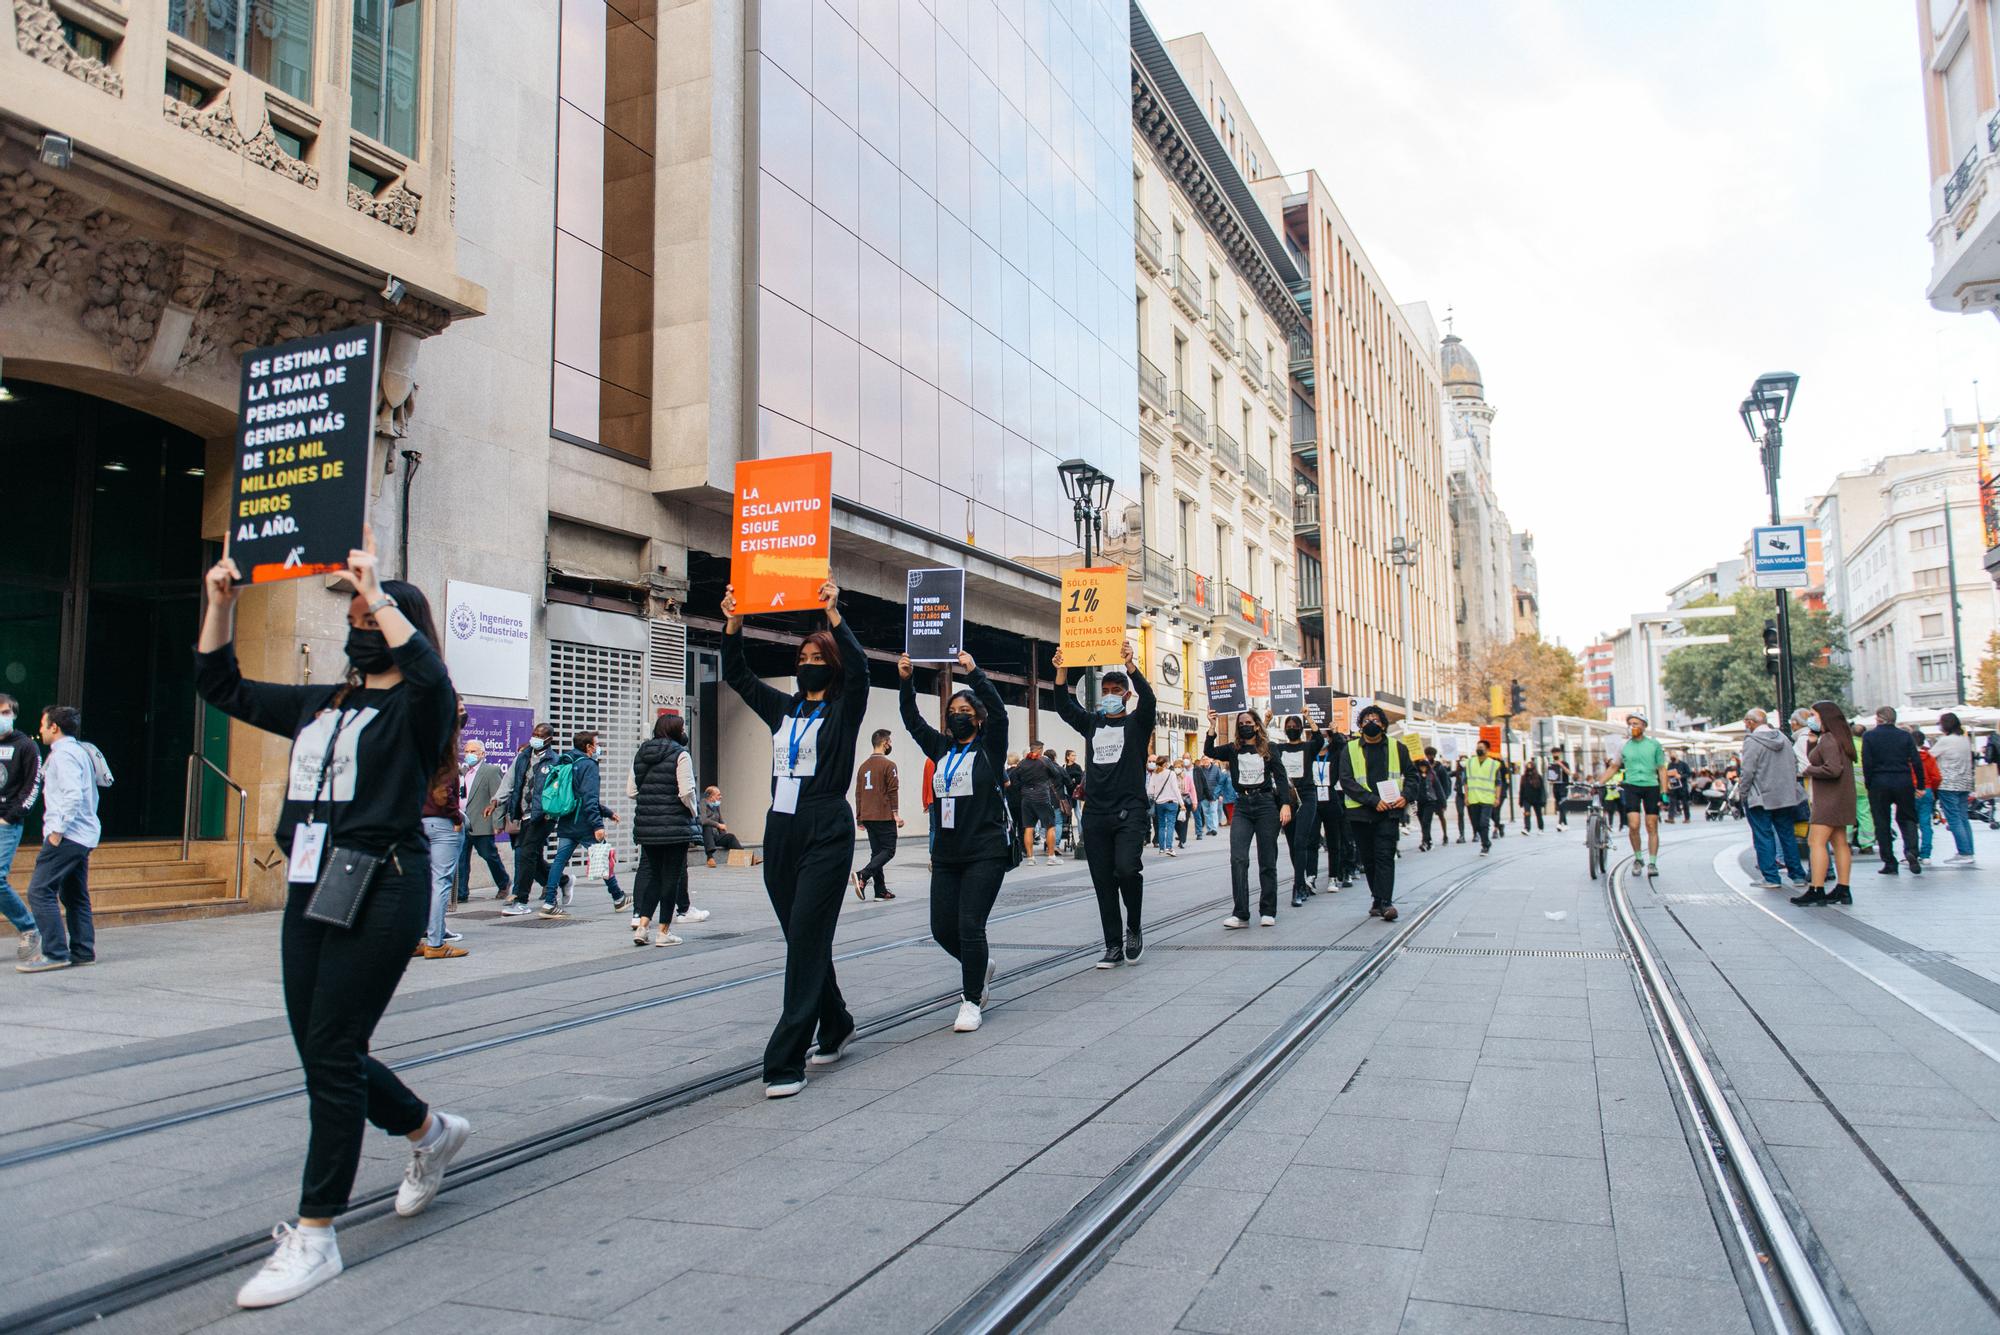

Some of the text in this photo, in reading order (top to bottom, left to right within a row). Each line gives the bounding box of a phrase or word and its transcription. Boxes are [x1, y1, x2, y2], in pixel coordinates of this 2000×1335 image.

[250, 339, 367, 378] SE ESTIMA QUE
[248, 367, 346, 400] LA TRATA DE
[246, 393, 329, 424] PERSONAS
[245, 412, 345, 446] GENERA MÁS
[243, 440, 327, 470] DE 126 MIL
[241, 461, 344, 493] MILLONES DE
[743, 488, 759, 500] LA
[239, 494, 291, 517] EUROS
[742, 498, 821, 517] ESCLAVITUD
[237, 515, 299, 541] AL AÑO.
[741, 520, 780, 535] SIGUE
[741, 534, 817, 552] EXISTIENDO
[1067, 587, 1100, 613] 1%
[480, 612, 523, 627] Ingenieros
[480, 623, 528, 639] Industriales
[1105, 626, 1122, 634] SON
[1065, 638, 1120, 648] RESCATADAS.
[652, 693, 675, 705] COSO
[485, 738, 503, 749] ética
[864, 770, 873, 790] 1
